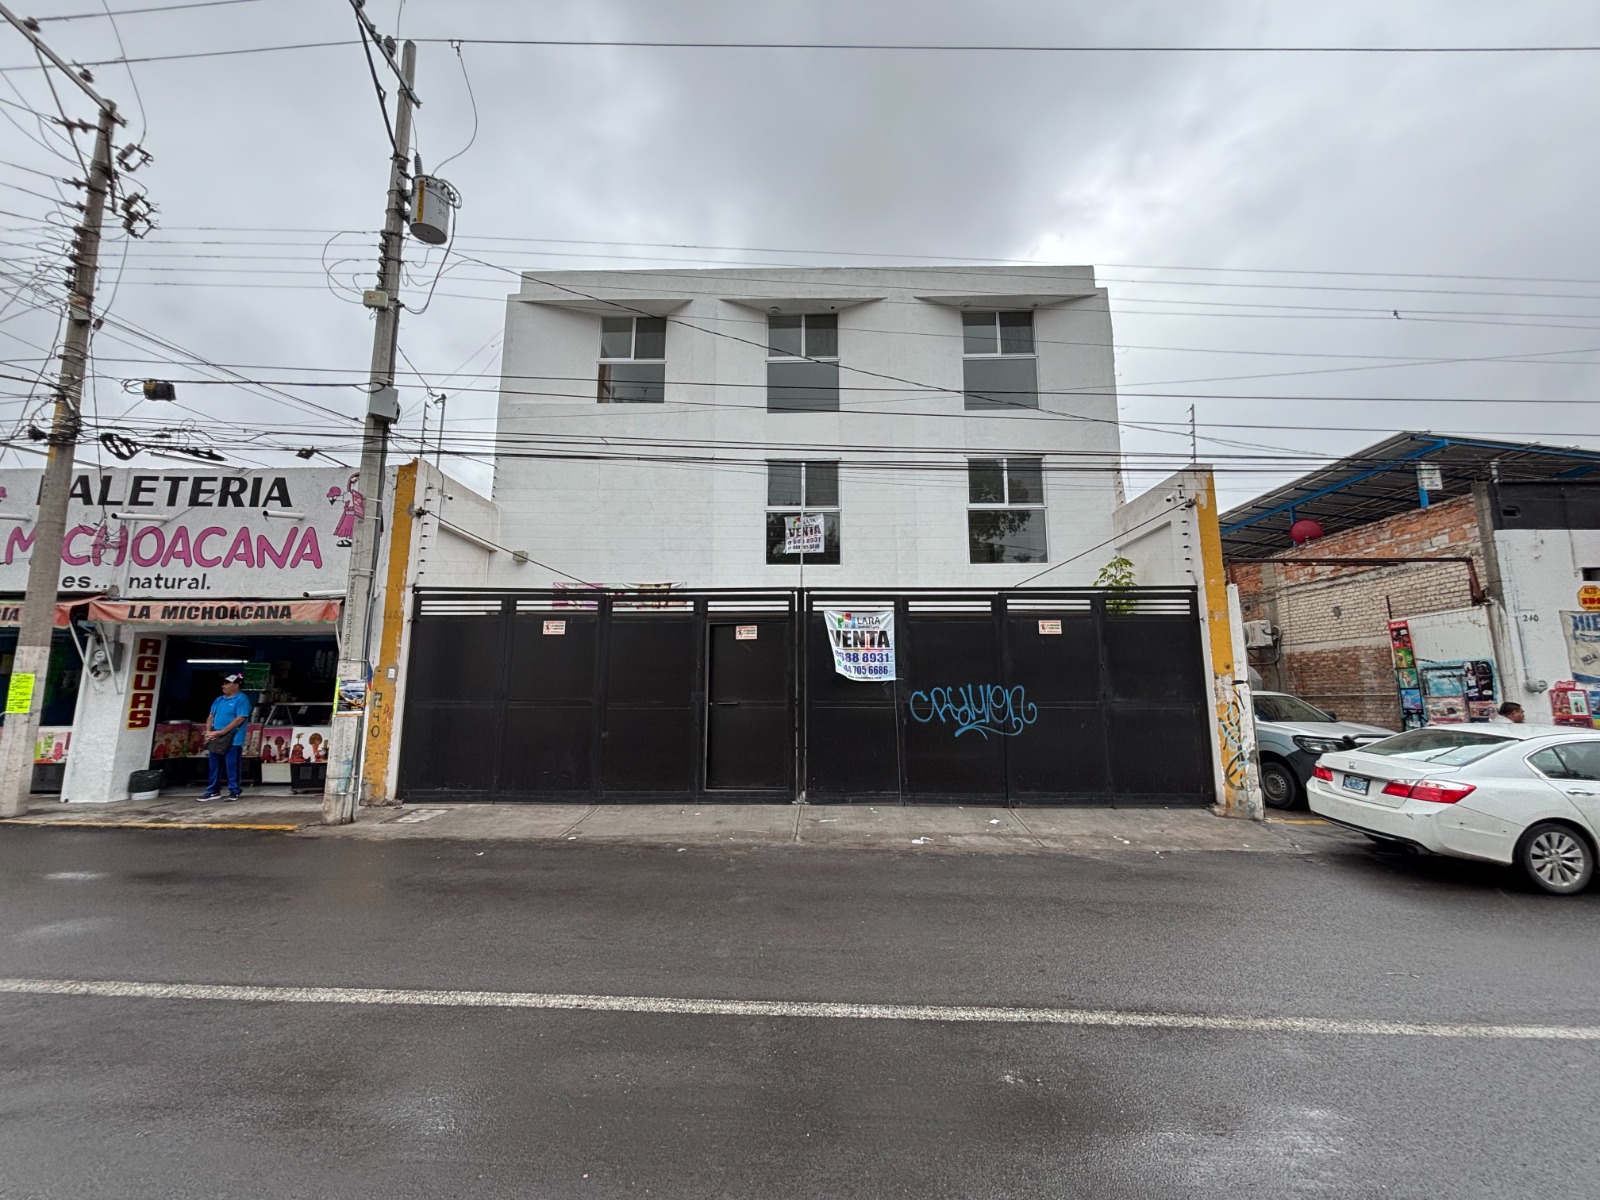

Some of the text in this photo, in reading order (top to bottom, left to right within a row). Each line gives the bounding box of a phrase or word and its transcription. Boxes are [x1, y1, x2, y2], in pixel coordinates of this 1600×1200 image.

[36, 474, 292, 507] ALETERIA
[5, 525, 322, 569] MCHOACANA
[129, 573, 210, 589] natural.
[128, 605, 292, 620] LA MICHOACANA
[857, 616, 880, 624] LARA
[829, 630, 890, 647] VENTA
[862, 653, 889, 662] 8931
[853, 666, 866, 674] 705
[868, 666, 888, 674] 6686
[127, 638, 161, 729] AGUAS
